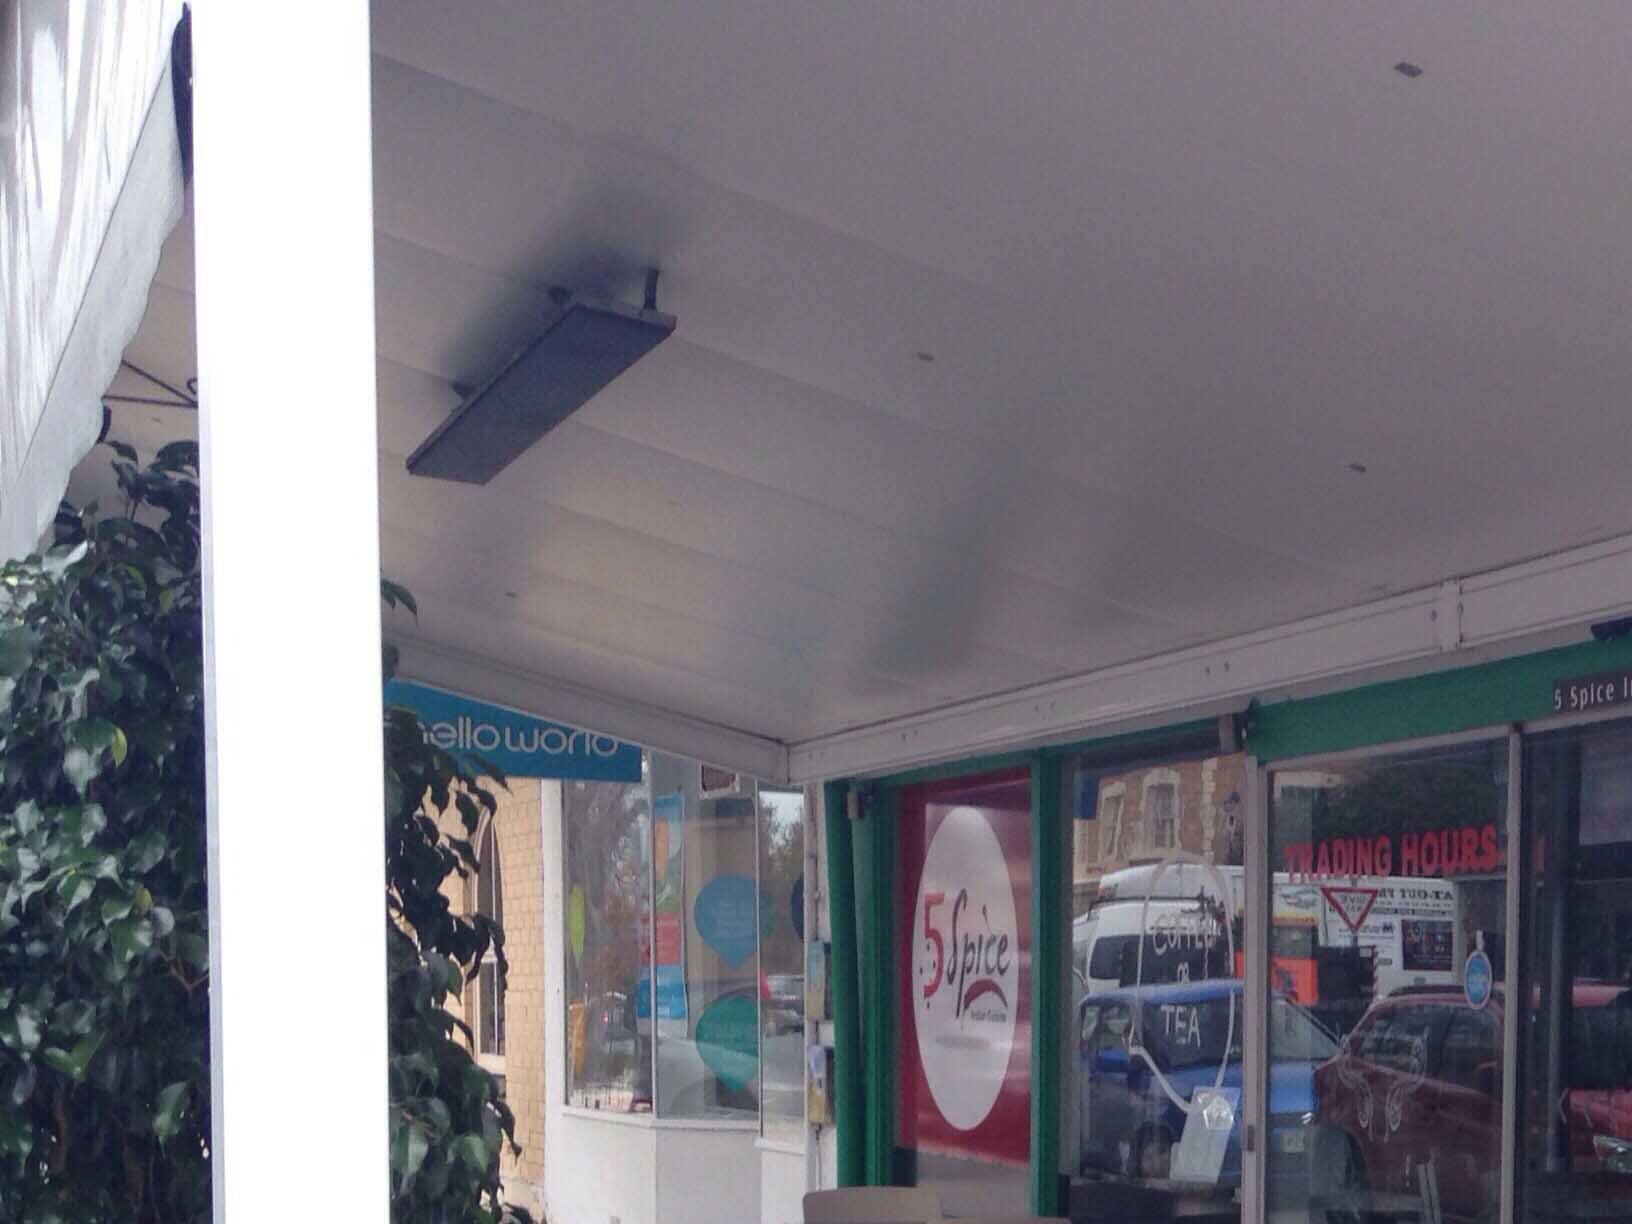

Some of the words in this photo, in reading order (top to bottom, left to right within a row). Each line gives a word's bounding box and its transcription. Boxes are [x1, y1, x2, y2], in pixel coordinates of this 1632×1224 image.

[1554, 688, 1562, 711] 5
[1570, 682, 1615, 709] Spice
[1284, 833, 1392, 884] TRADING
[1401, 823, 1496, 876] HOURS
[923, 892, 945, 998] 5
[947, 888, 1010, 1020] Spice
[1161, 1004, 1201, 1048] TEA
